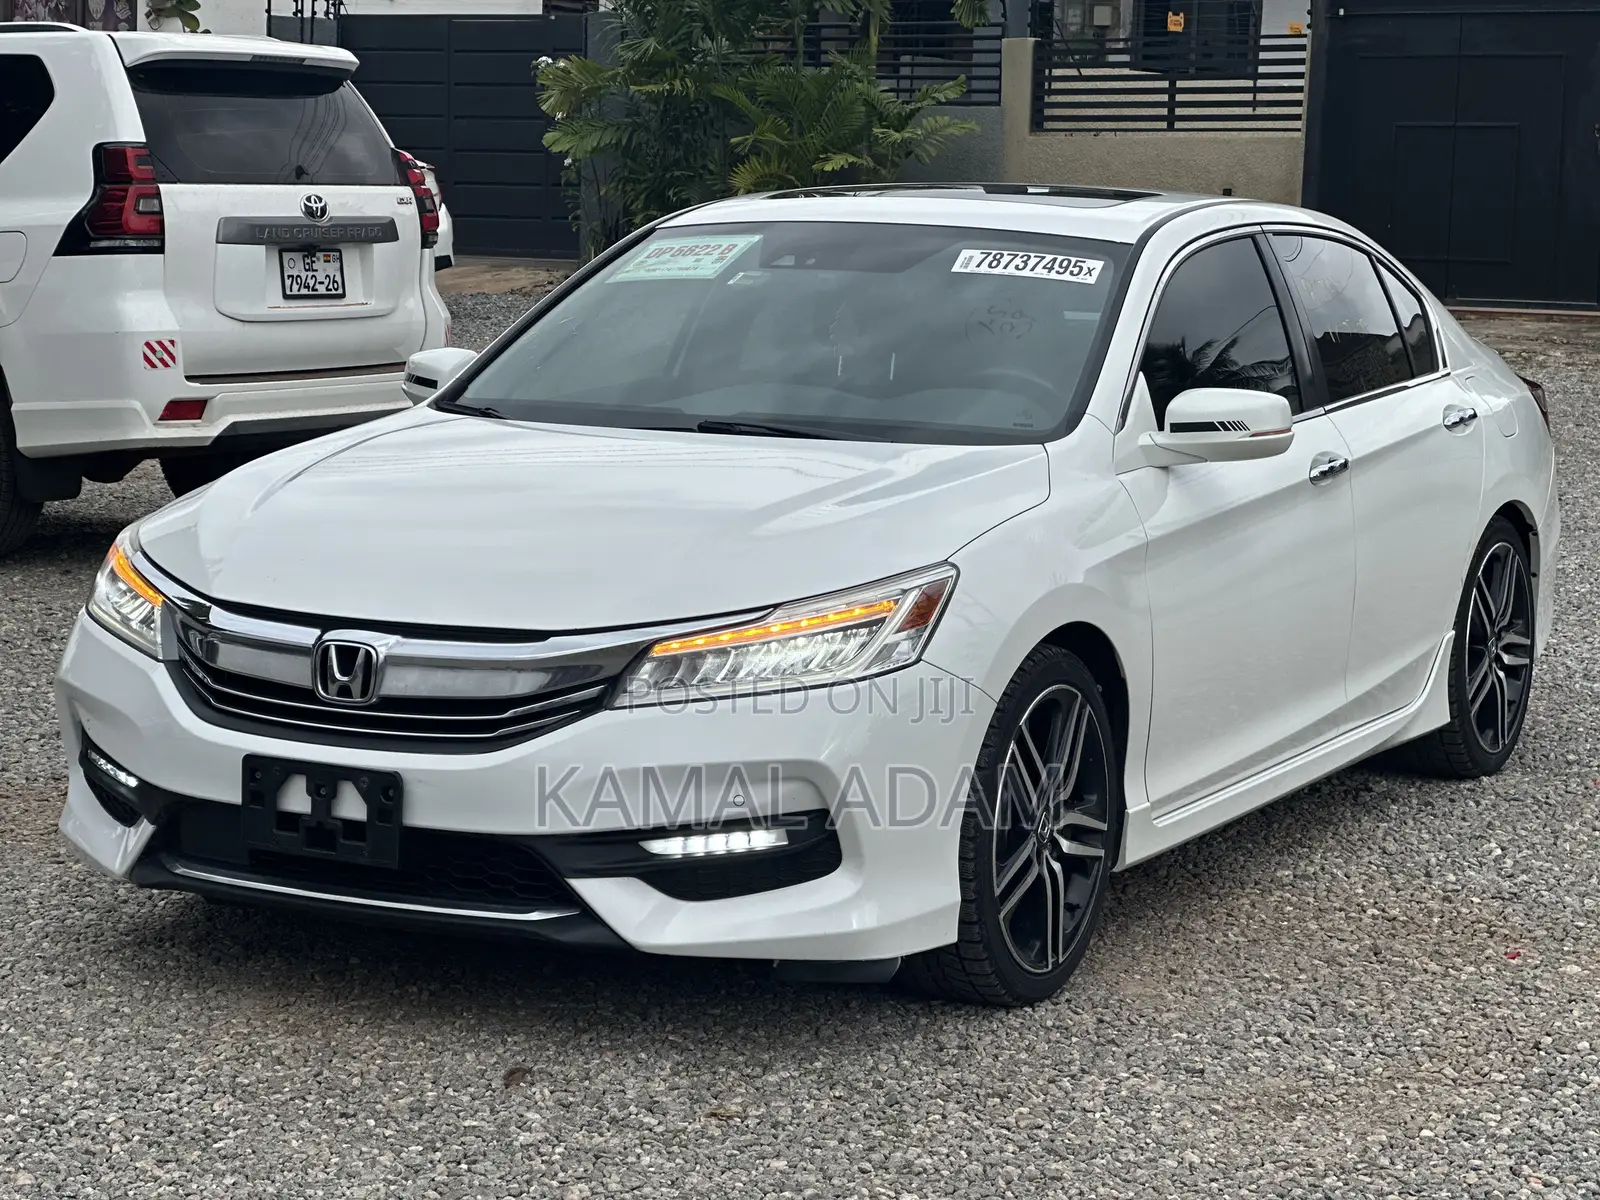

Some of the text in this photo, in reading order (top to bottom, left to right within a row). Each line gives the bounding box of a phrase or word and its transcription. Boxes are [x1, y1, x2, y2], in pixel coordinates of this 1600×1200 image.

[256, 227, 290, 238] LAND
[293, 227, 345, 238] CRUISER
[302, 254, 318, 272] GE
[287, 273, 340, 293] 7942-26
